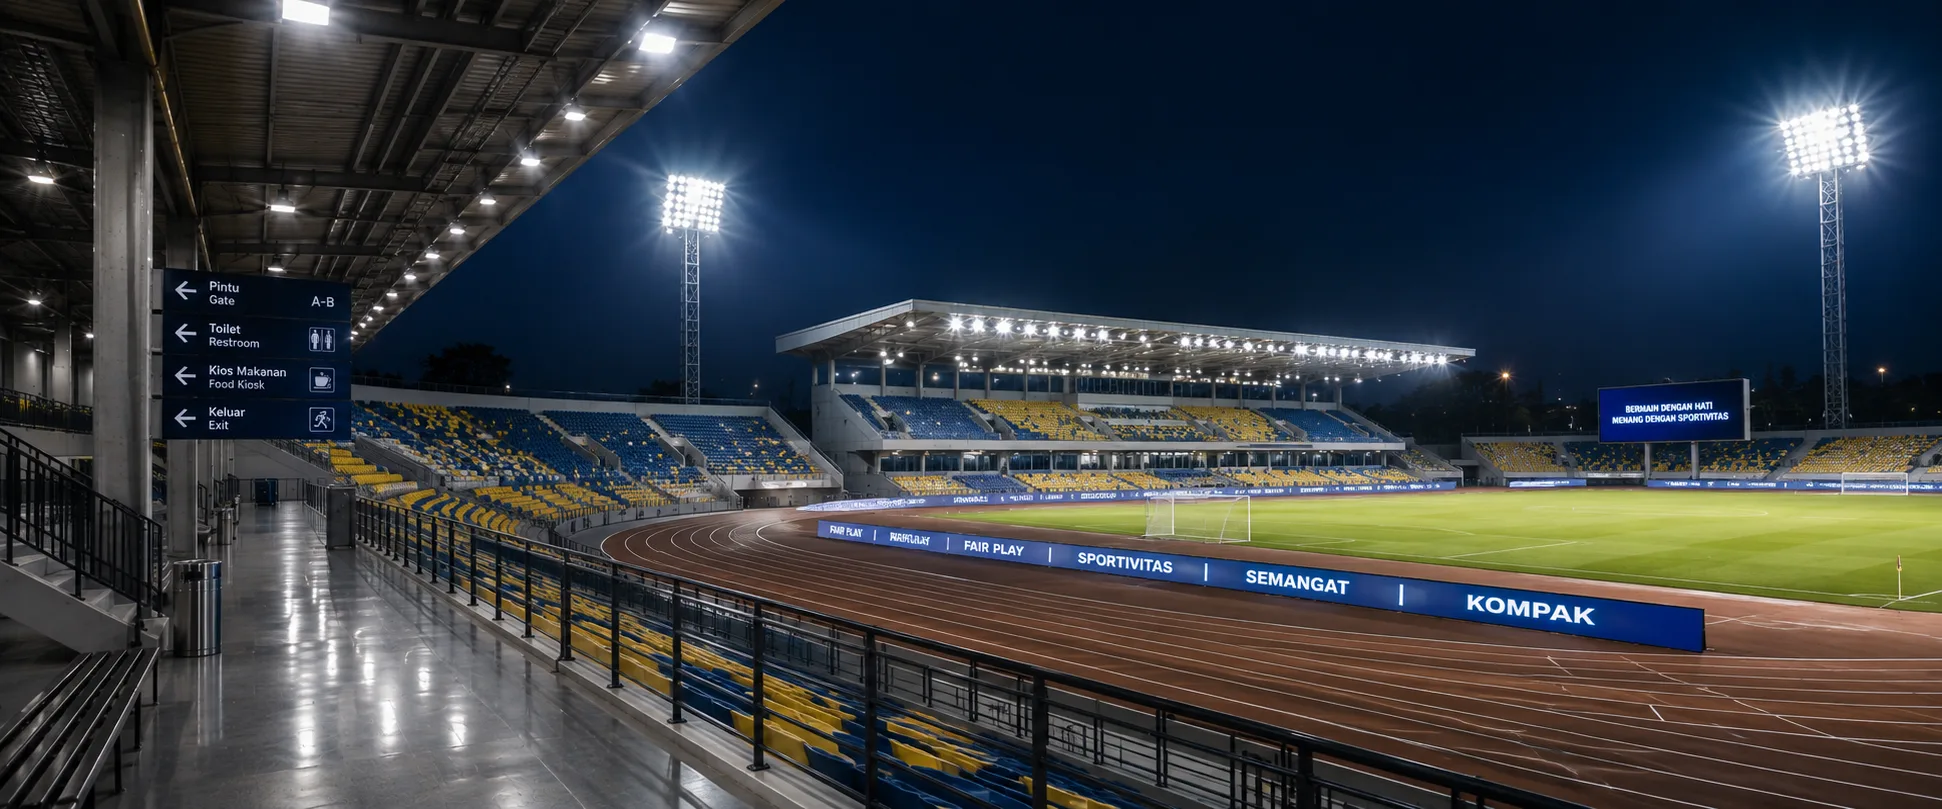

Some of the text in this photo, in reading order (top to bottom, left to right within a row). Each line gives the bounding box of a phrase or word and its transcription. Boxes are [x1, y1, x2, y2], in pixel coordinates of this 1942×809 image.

[209, 280, 240, 293] Pintu
[209, 295, 236, 306] Gate
[311, 295, 335, 308] A-B
[208, 323, 241, 335] Toilet
[209, 337, 260, 349] Restroom
[208, 365, 287, 378] Kios Makanan
[208, 379, 265, 390] Food Kiosk
[208, 406, 246, 418] Keluar
[1694, 401, 1713, 411] HATI
[1677, 411, 1729, 422] SPORTIVITAS
[208, 420, 229, 431] Exit
[964, 540, 1025, 557] FAIR PLAY
[1077, 552, 1174, 574] SPORTIVITAS
[1245, 569, 1351, 595] SEMANGAT
[1466, 593, 1597, 626] KOMPAK
